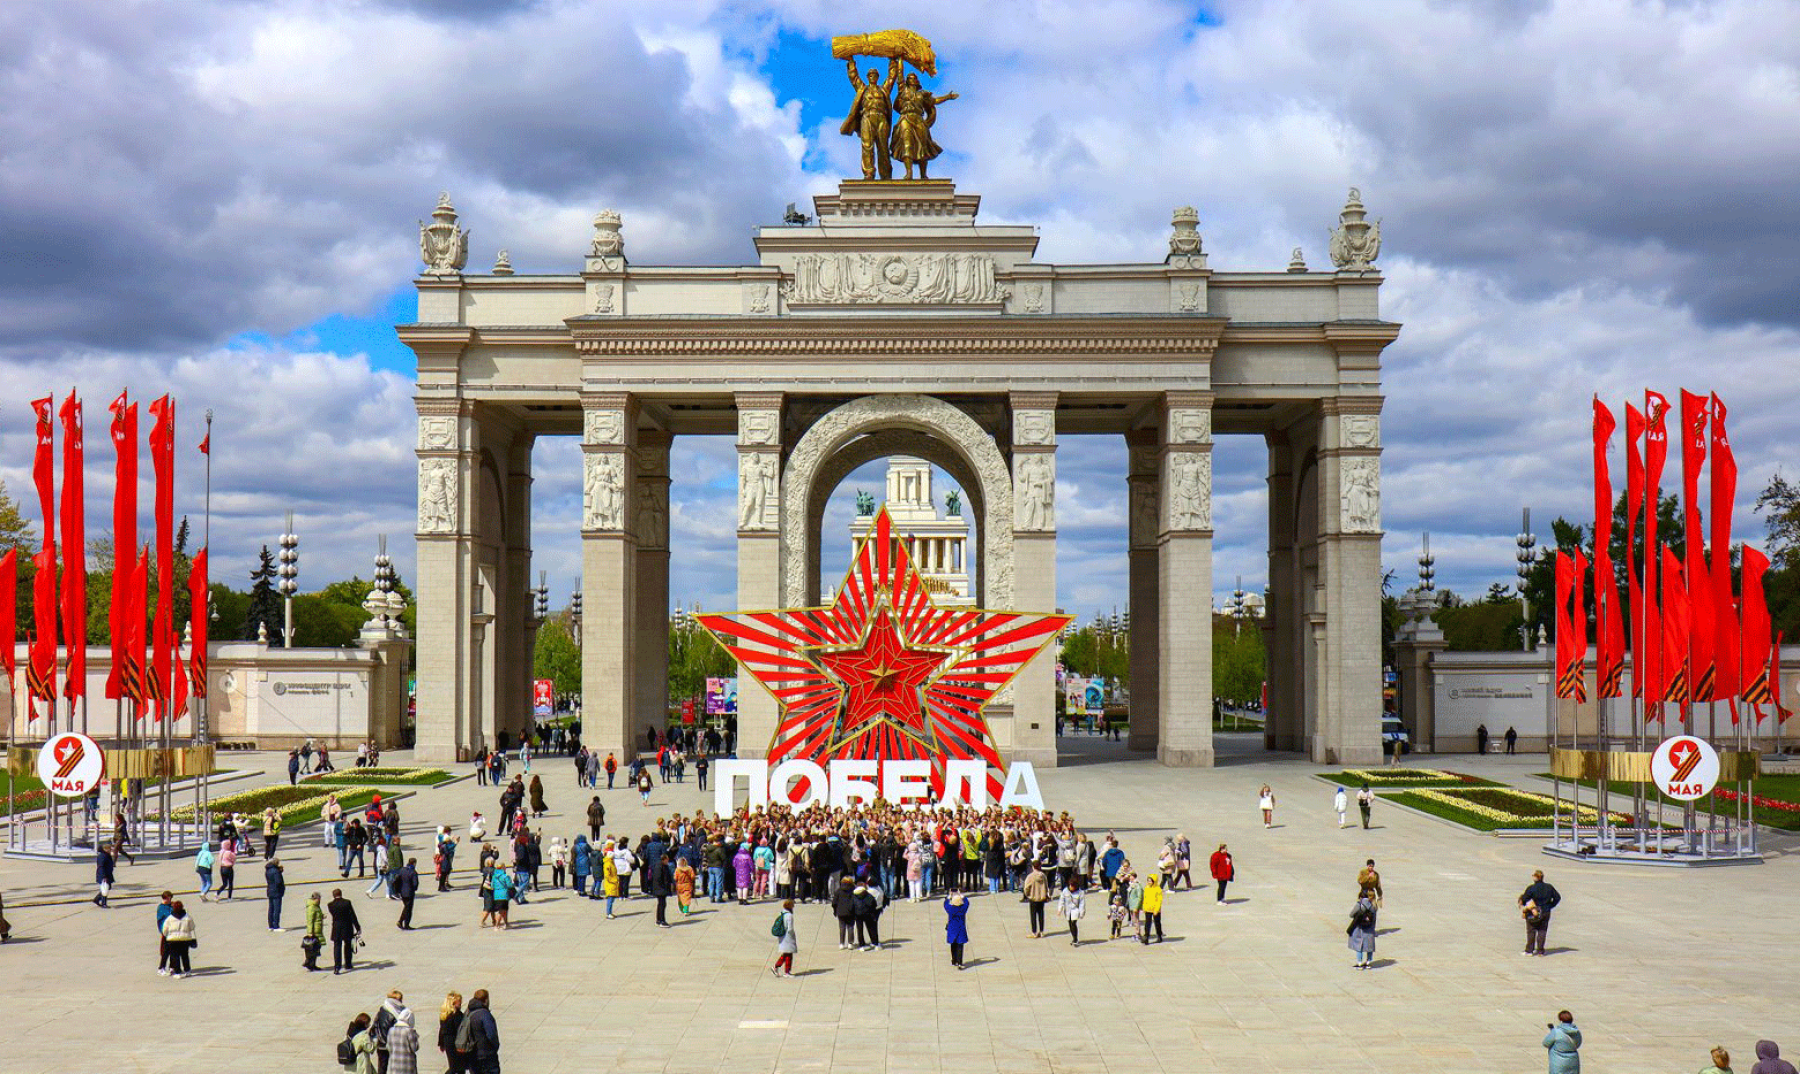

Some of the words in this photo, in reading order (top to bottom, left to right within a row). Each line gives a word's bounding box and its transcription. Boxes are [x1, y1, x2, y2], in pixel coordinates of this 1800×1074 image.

[52, 779, 84, 791] МАЯ
[714, 759, 1046, 820] ПОБЕДА
[1668, 784, 1703, 795] МАЯ
